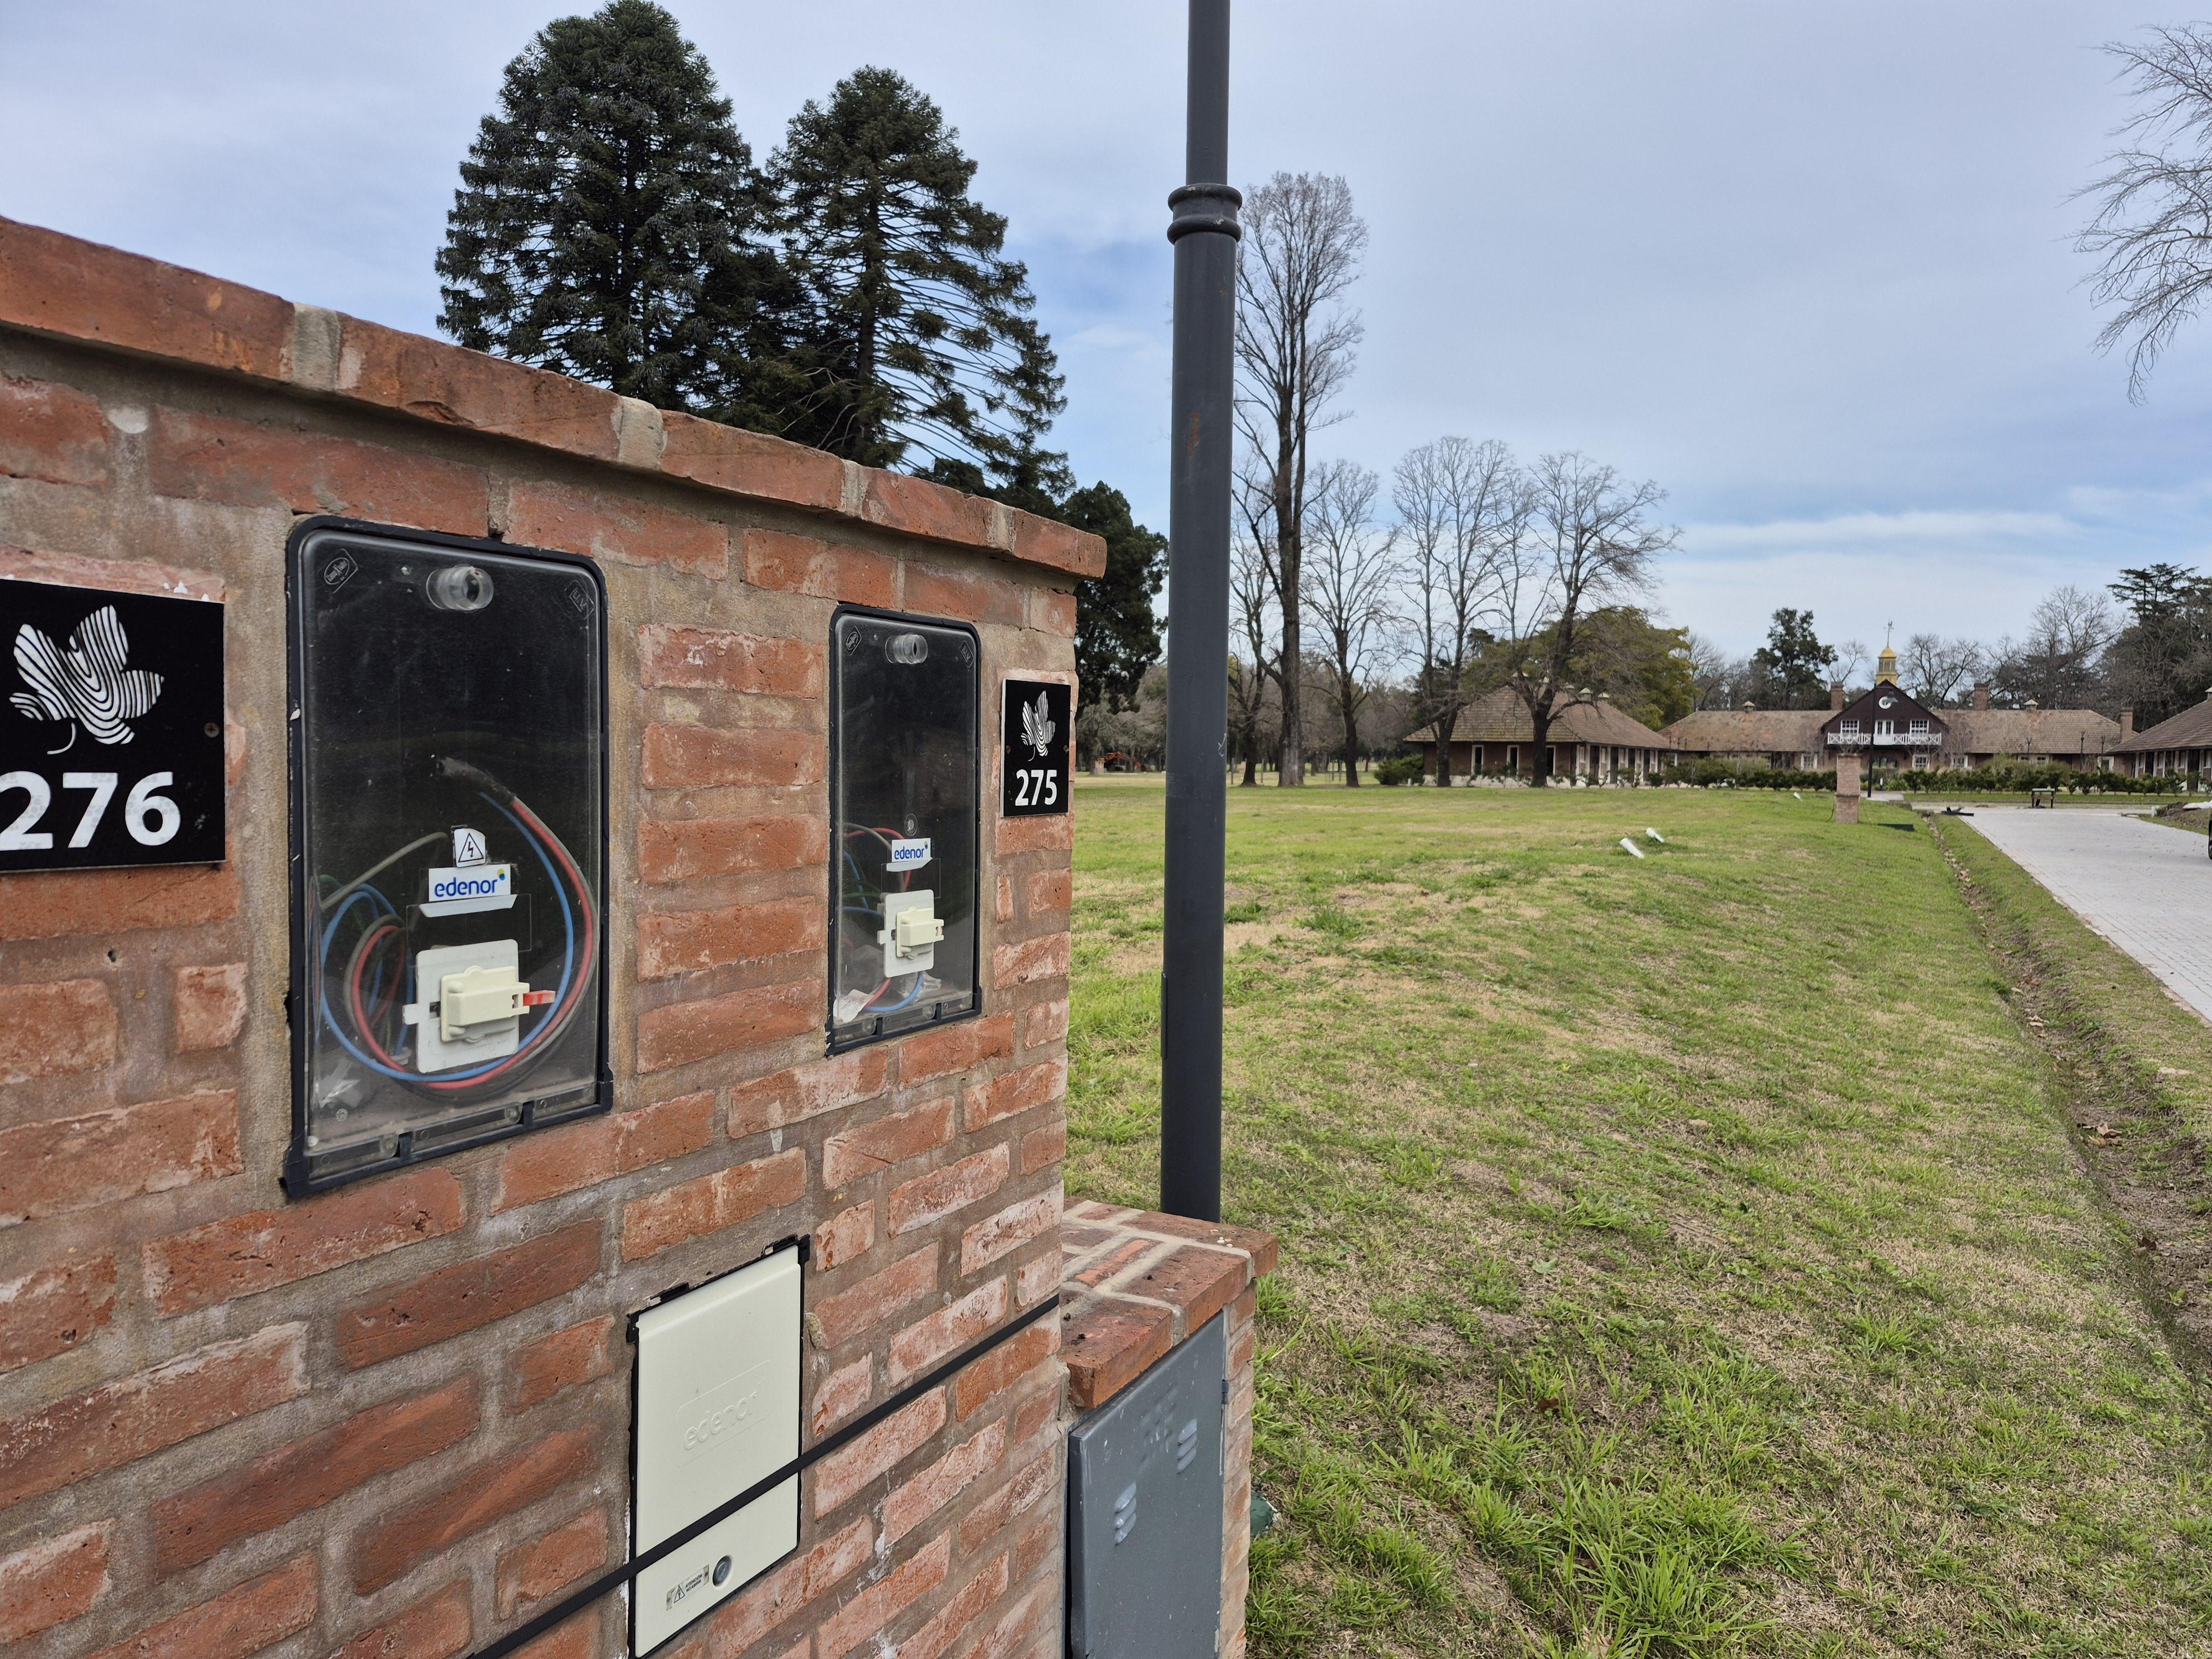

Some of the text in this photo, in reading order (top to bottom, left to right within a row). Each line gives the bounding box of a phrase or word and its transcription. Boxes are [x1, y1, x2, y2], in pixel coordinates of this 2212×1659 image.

[1015, 769, 1057, 806] 275
[0, 770, 181, 851] 276
[894, 846, 925, 860] edenor
[434, 877, 498, 898] edenor
[684, 1390, 757, 1451] edenor
